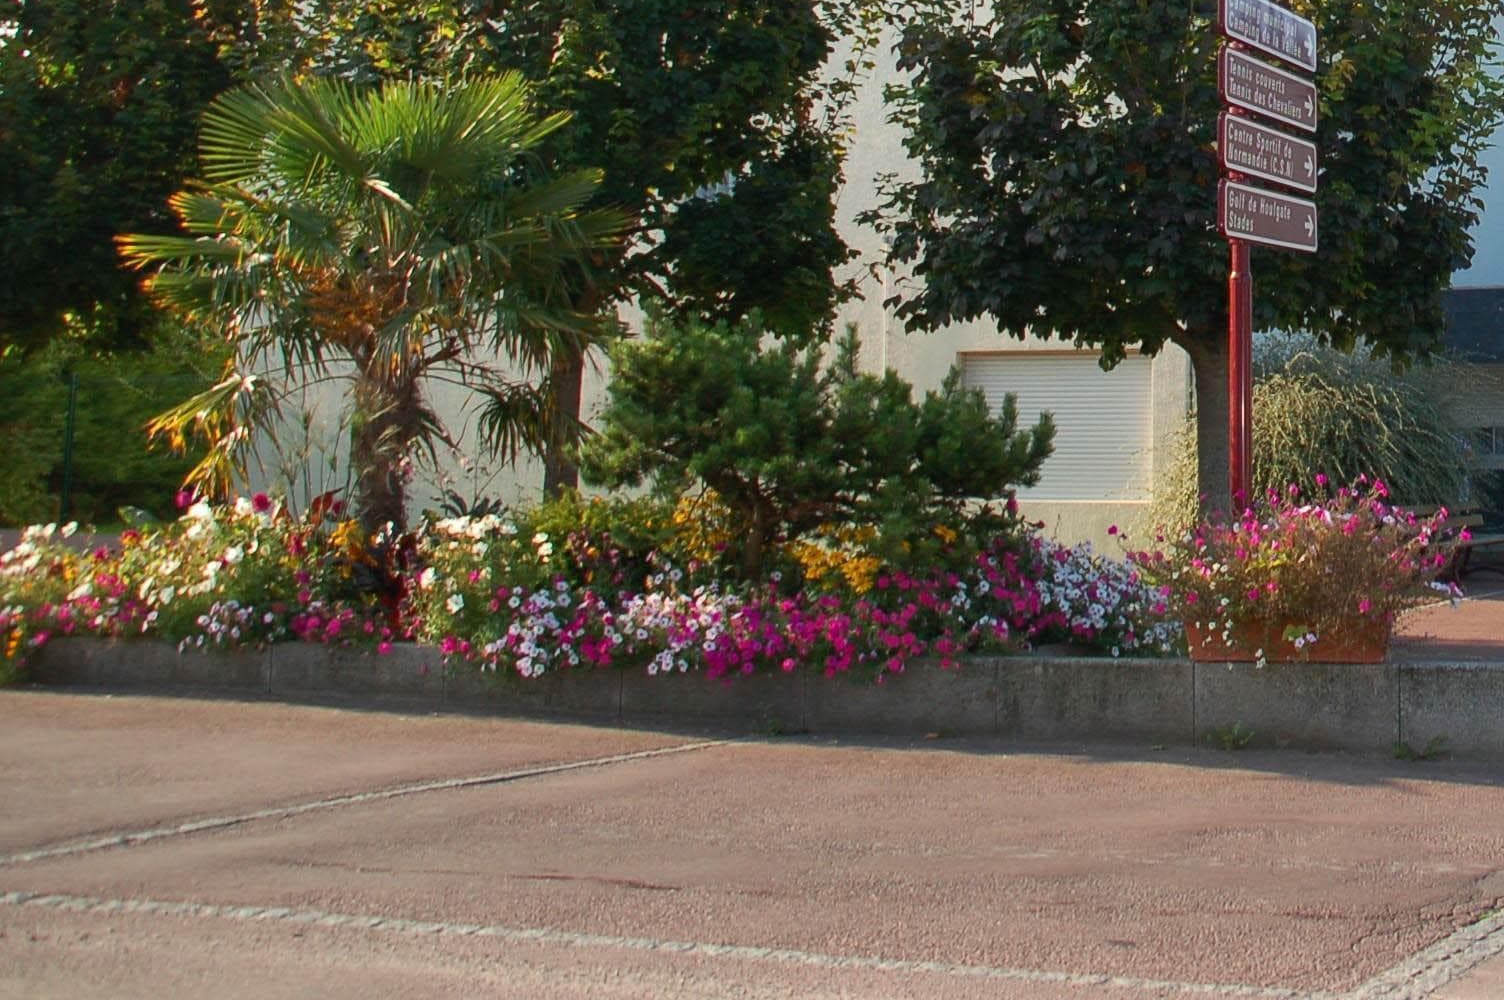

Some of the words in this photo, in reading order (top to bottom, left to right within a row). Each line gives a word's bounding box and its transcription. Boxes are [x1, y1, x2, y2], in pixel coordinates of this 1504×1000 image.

[1229, 11, 1260, 42] Camping
[1262, 27, 1270, 45] de
[1230, 57, 1252, 81] Tennis
[1256, 72, 1285, 94] couverts
[1229, 77, 1252, 100] Tennis
[1254, 87, 1266, 106] des
[1268, 93, 1302, 119] Chevaliers
[1228, 123, 1253, 146] Centre
[1256, 132, 1281, 153] Sportif
[1284, 142, 1292, 159] de
[1228, 143, 1267, 169] Normandie
[1228, 210, 1254, 232] Stades
[1229, 190, 1245, 209] Golf
[1248, 196, 1257, 213] de
[1260, 199, 1291, 222] Houlgate
